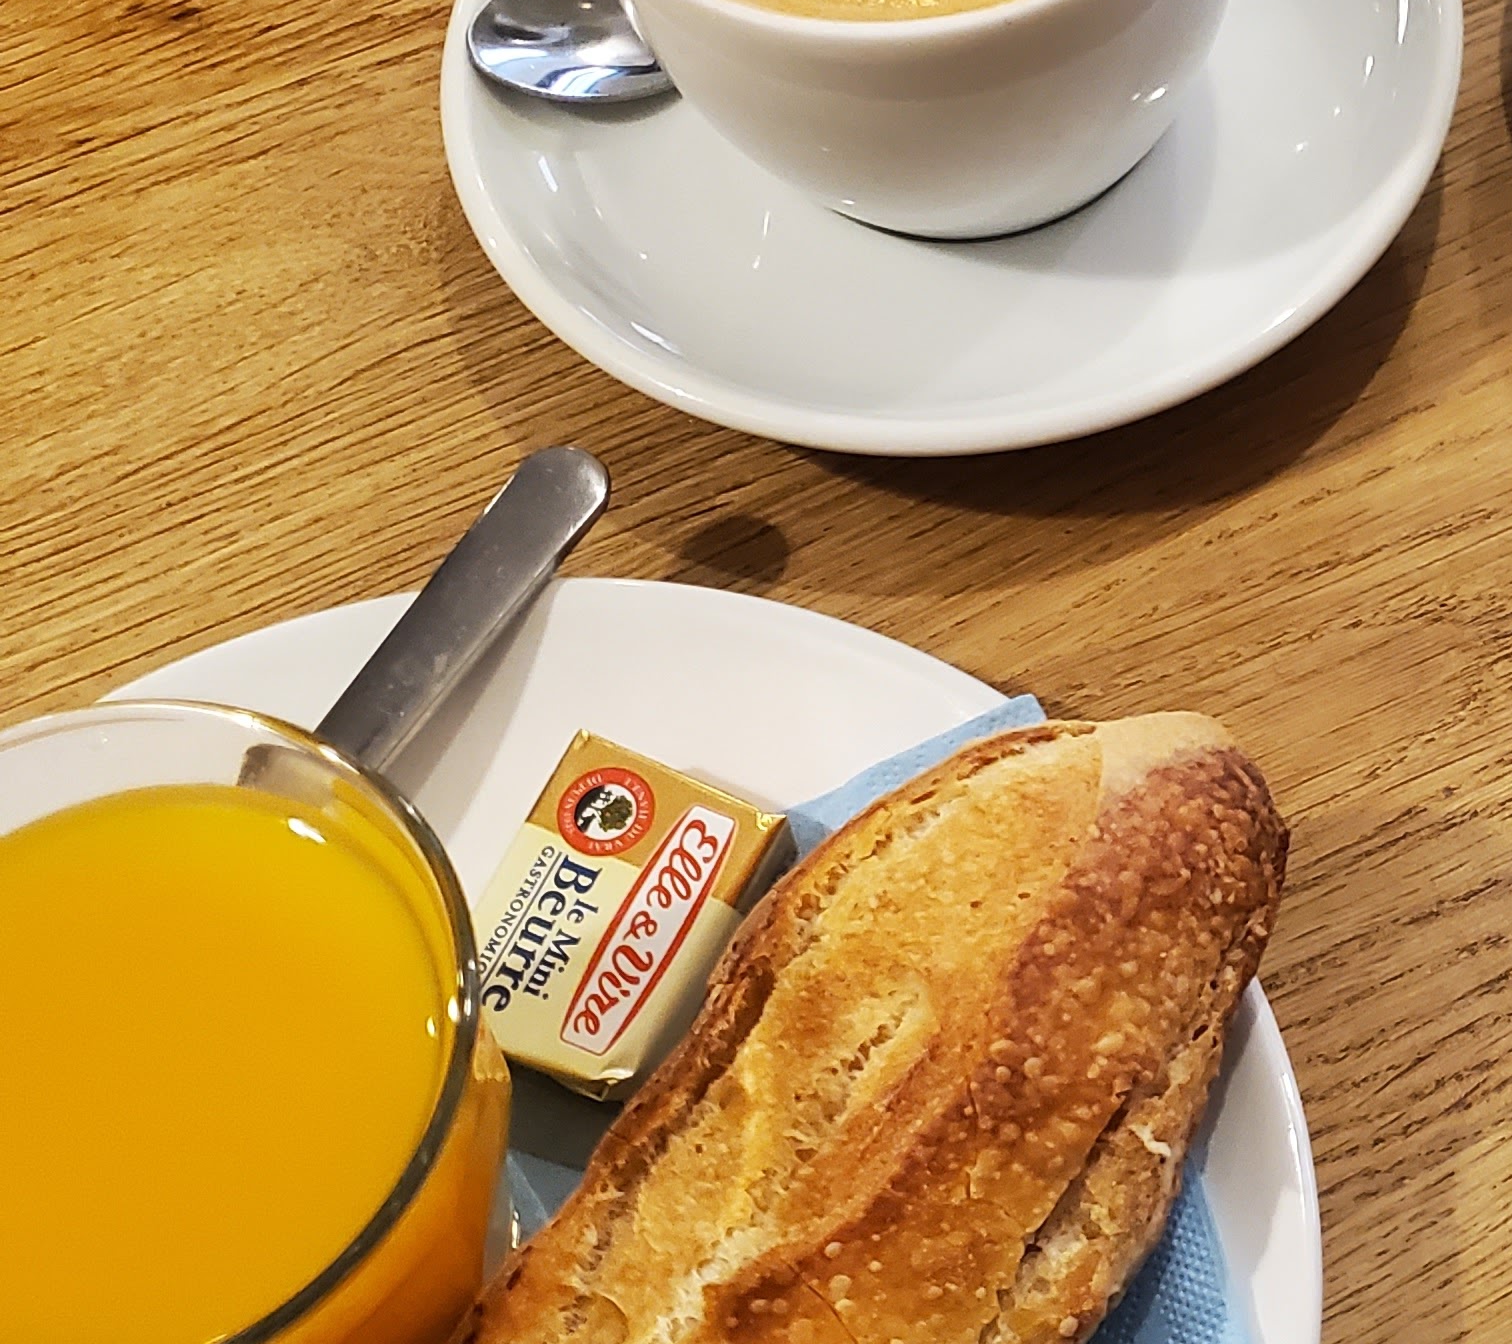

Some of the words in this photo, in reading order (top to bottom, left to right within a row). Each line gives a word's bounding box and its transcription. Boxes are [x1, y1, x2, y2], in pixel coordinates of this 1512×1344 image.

[646, 819, 718, 909] Elle
[479, 845, 555, 975] GASTRONOMI
[482, 855, 603, 1012] Beurre
[576, 897, 599, 924] le
[624, 911, 658, 940] &
[523, 927, 581, 1000] Mini
[573, 945, 654, 1036] Vire
